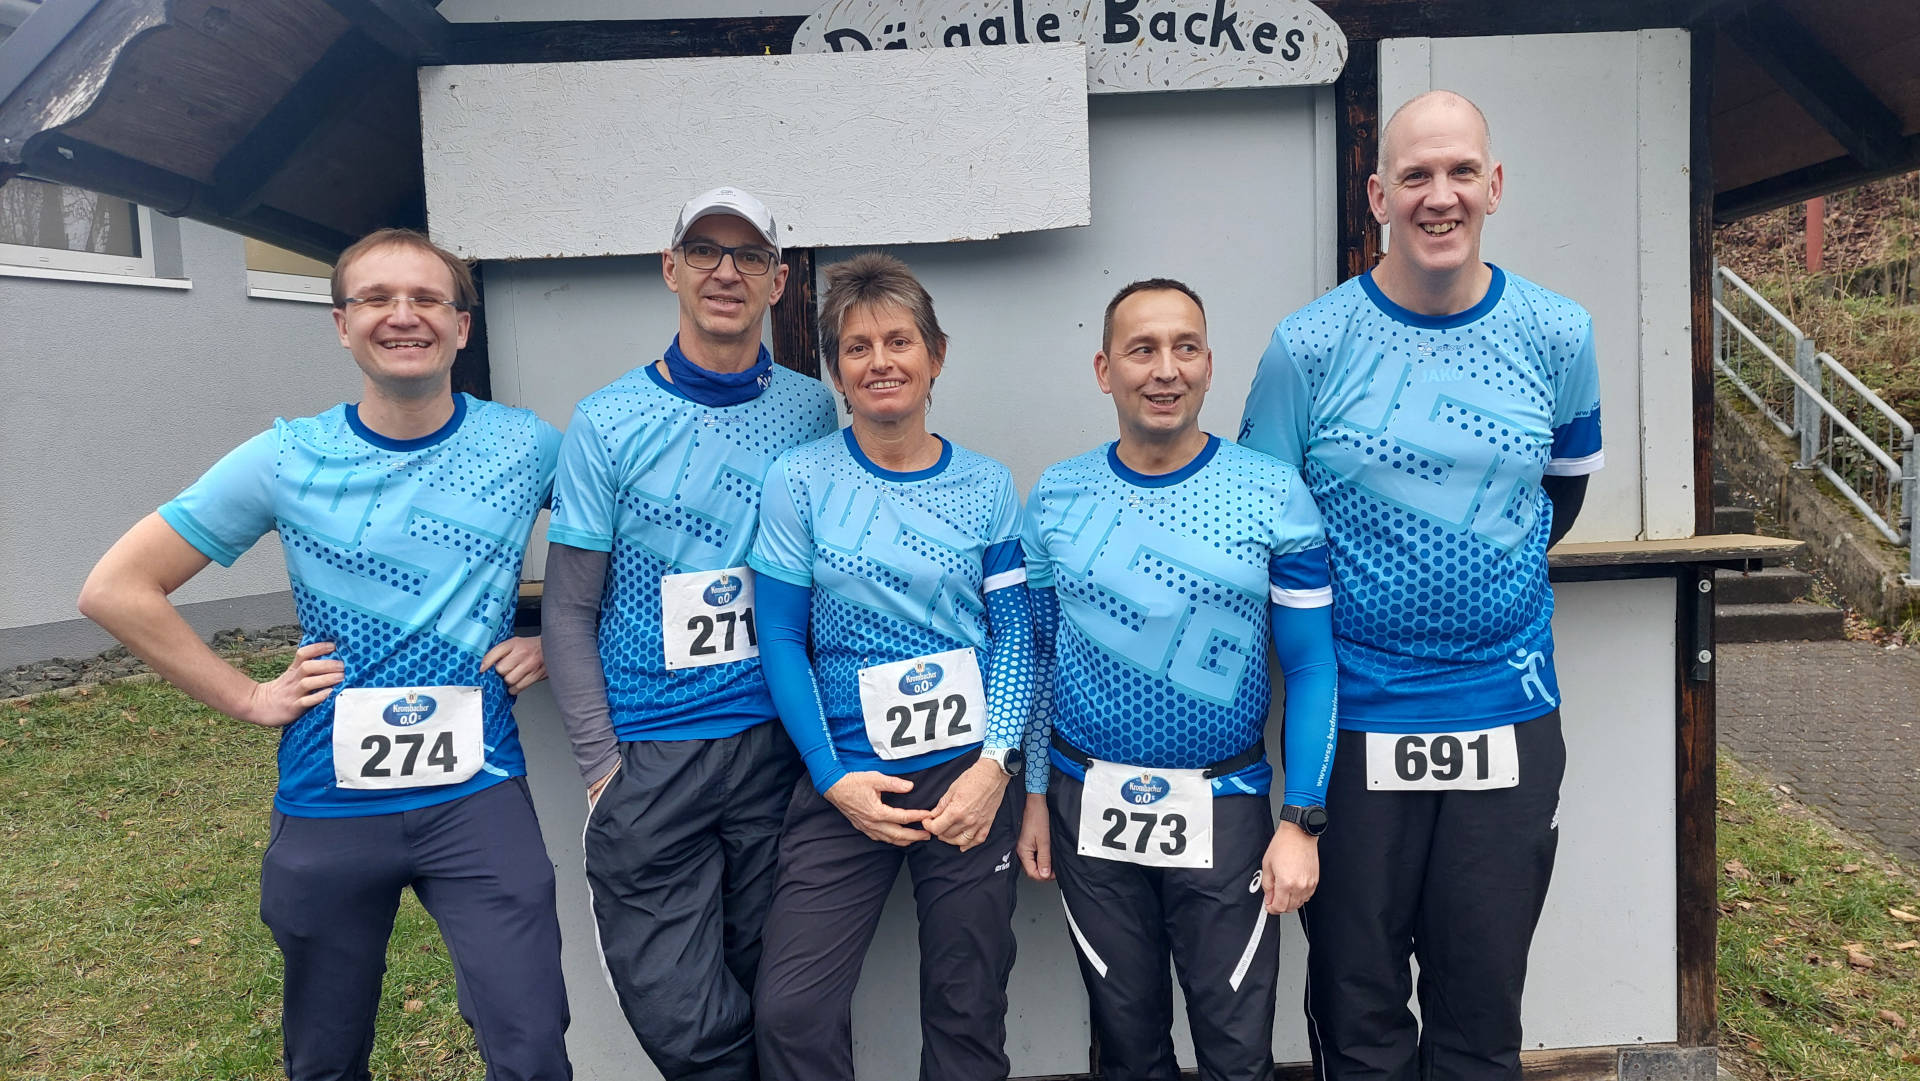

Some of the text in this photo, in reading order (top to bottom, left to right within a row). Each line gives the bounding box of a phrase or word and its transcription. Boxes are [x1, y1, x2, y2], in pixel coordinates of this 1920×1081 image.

[1103, 0, 1304, 61] Backes
[1419, 366, 1463, 382] JAKO
[687, 607, 757, 656] 271
[906, 670, 937, 684] Krombacher
[392, 703, 430, 713] Krombacher
[886, 693, 972, 749] 272
[360, 731, 458, 778] 274
[1394, 734, 1489, 782] 691
[1101, 807, 1187, 856] 273
